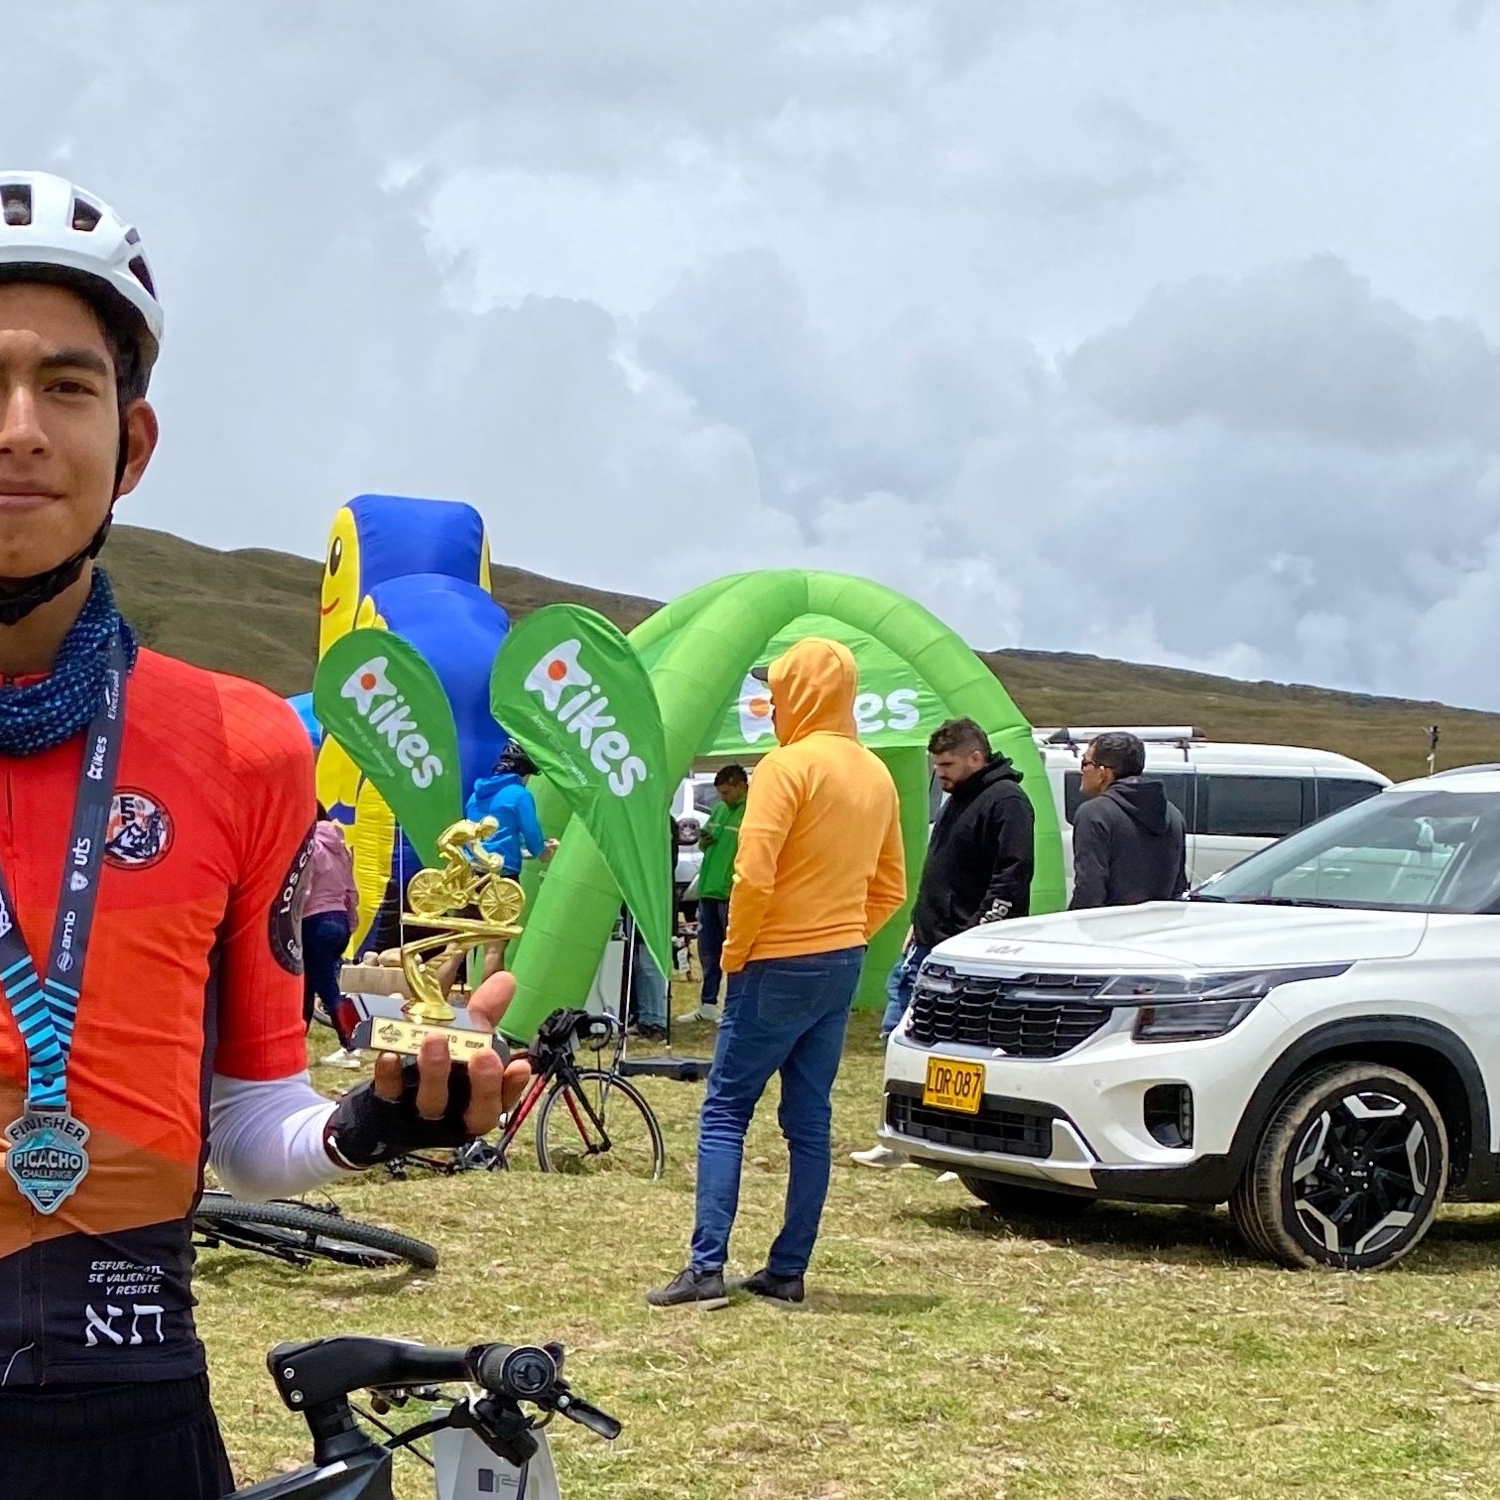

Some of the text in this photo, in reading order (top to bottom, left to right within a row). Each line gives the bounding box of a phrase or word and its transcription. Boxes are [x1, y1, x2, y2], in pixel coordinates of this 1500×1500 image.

[72, 837, 91, 866] uts
[280, 872, 299, 914] LOS
[62, 910, 76, 950] amb
[10, 1116, 85, 1141] FINISHER
[13, 1149, 82, 1170] PICACHO
[21, 1169, 73, 1180] CHALLENGE
[88, 1273, 105, 1283] SE
[106, 1284, 162, 1296] Y RESISTE
